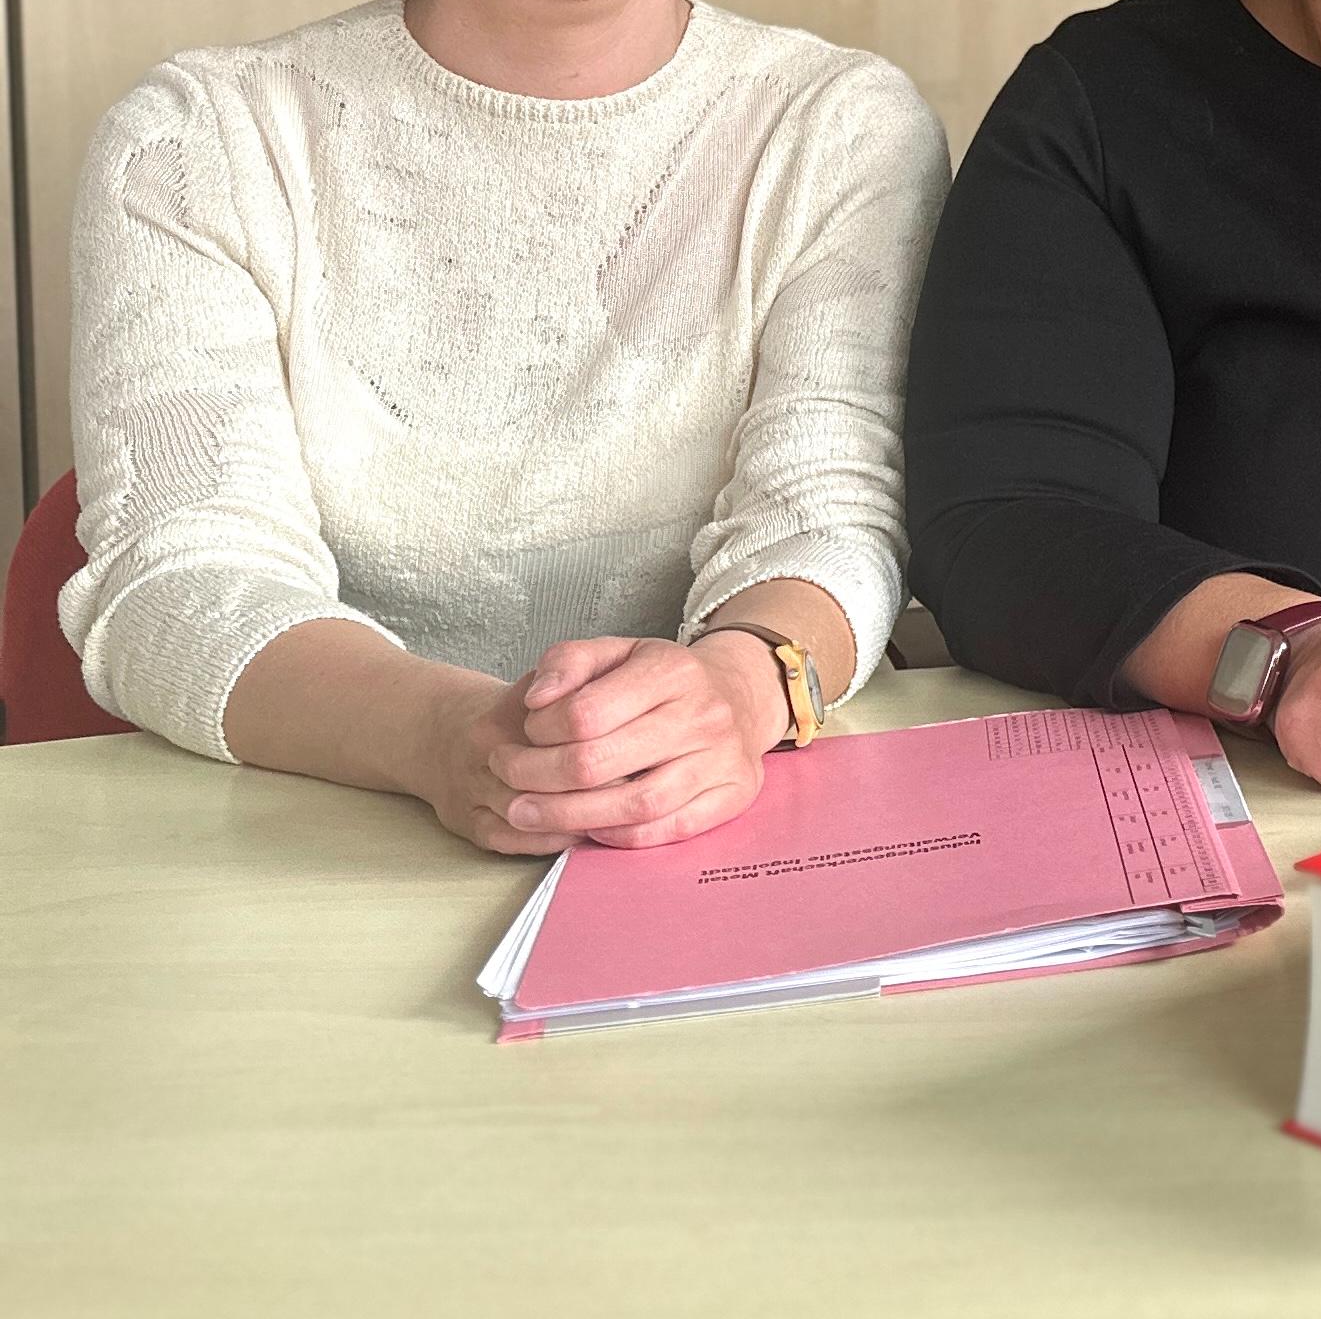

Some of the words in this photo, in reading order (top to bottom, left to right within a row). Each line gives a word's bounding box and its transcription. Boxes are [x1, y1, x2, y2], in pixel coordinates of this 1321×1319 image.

[765, 839, 982, 876] Industriegewerkschaft
[807, 832, 982, 861] Verwaltungsstelle
[698, 872, 759, 884] Metall
[701, 858, 801, 876] Ingolstadt
